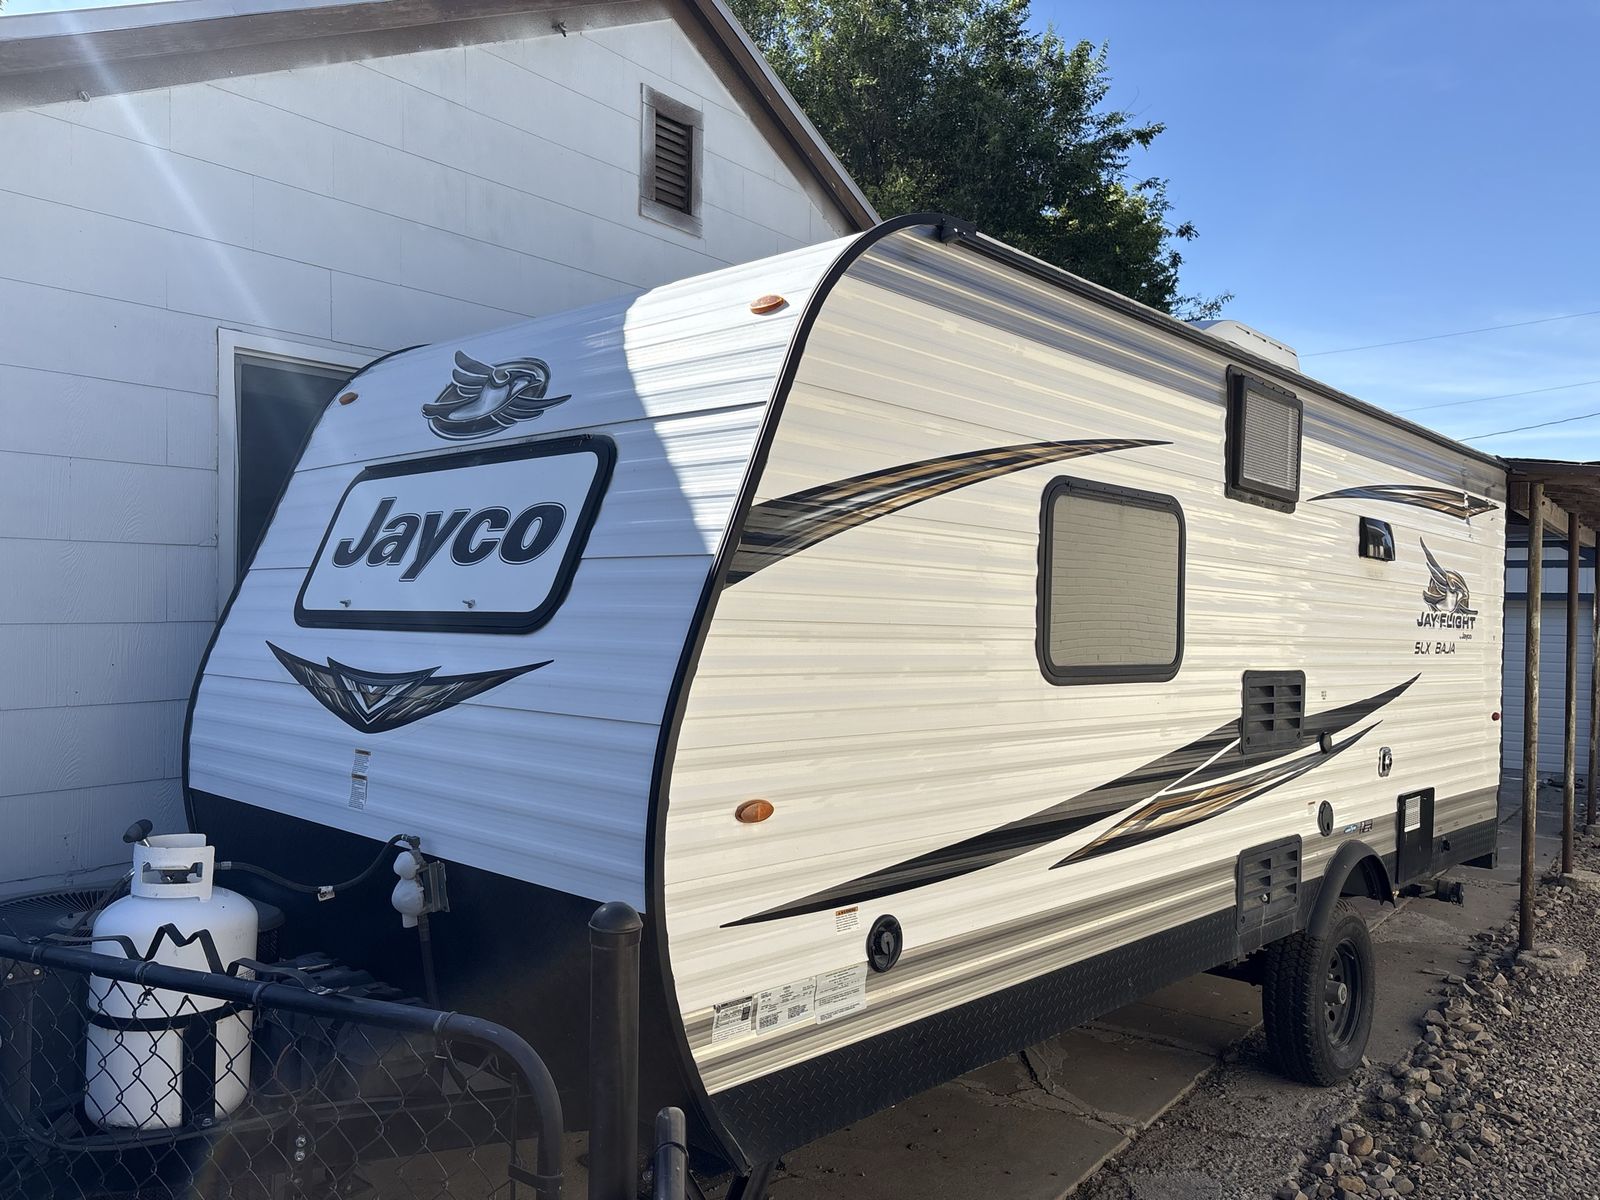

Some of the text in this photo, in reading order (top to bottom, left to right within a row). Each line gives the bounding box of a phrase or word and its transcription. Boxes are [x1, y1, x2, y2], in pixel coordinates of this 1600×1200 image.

[332, 496, 567, 582] Jayco
[1414, 641, 1455, 654] SLX BAJA
